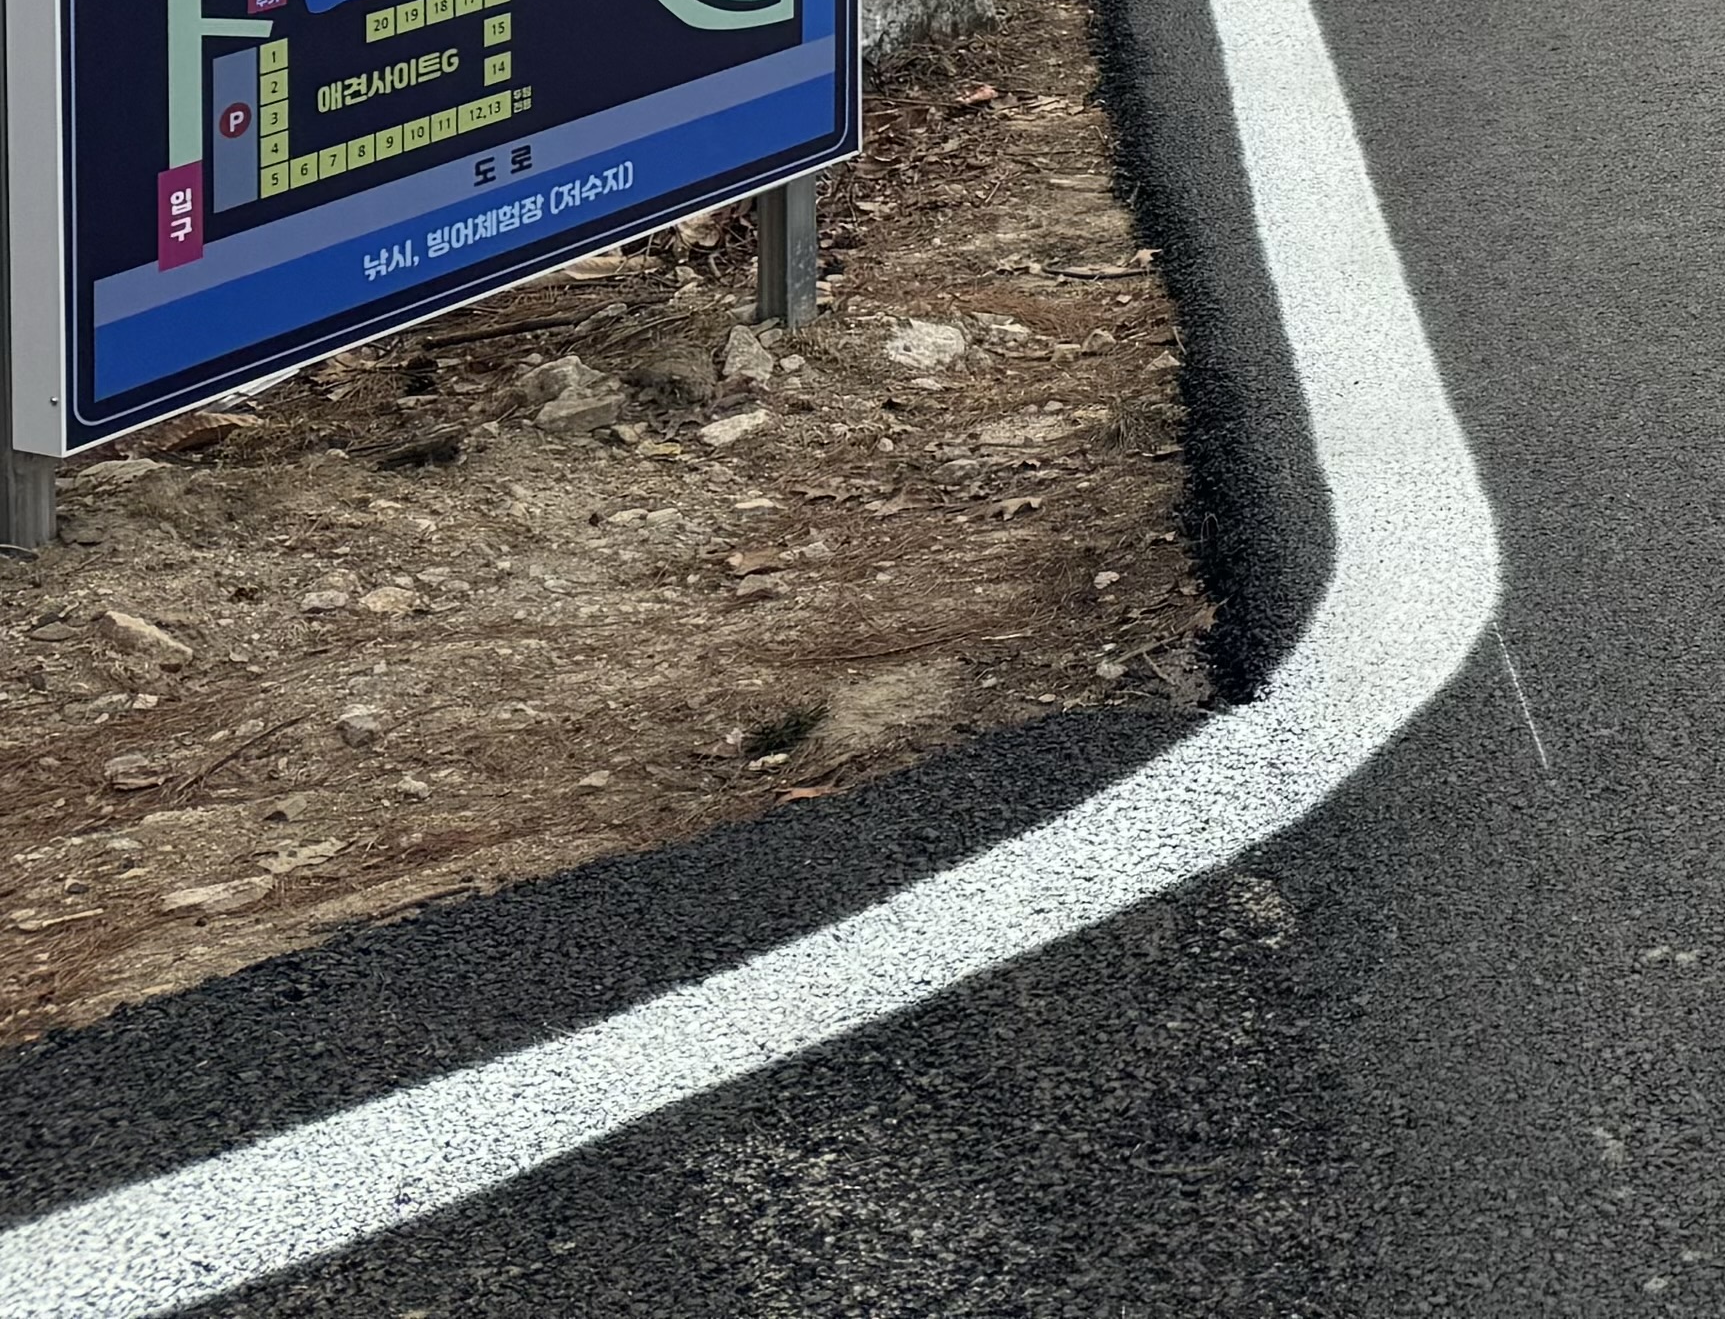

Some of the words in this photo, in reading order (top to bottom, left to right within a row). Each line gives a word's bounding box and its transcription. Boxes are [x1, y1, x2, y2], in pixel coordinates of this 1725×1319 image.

[433, 0, 448, 13] 18
[405, 8, 418, 22] 19
[373, 17, 389, 31] 20
[491, 21, 505, 35] 15
[271, 51, 276, 63] 1
[492, 61, 505, 75] 14
[271, 80, 278, 94] 2
[317, 48, 459, 113] 애견사이트G
[469, 101, 502, 120] 12,13
[230, 111, 244, 133] P
[270, 111, 278, 125] 3
[438, 117, 451, 131] 11
[410, 125, 424, 140] 10
[270, 142, 279, 154] 4
[386, 135, 394, 149] 9
[358, 144, 366, 158] 8
[330, 153, 337, 168] 7
[301, 162, 309, 176] 6
[271, 172, 279, 186] 5
[170, 188, 193, 242] 입구
[426, 195, 544, 257] 빙어체험장
[549, 161, 634, 215] (저수지)
